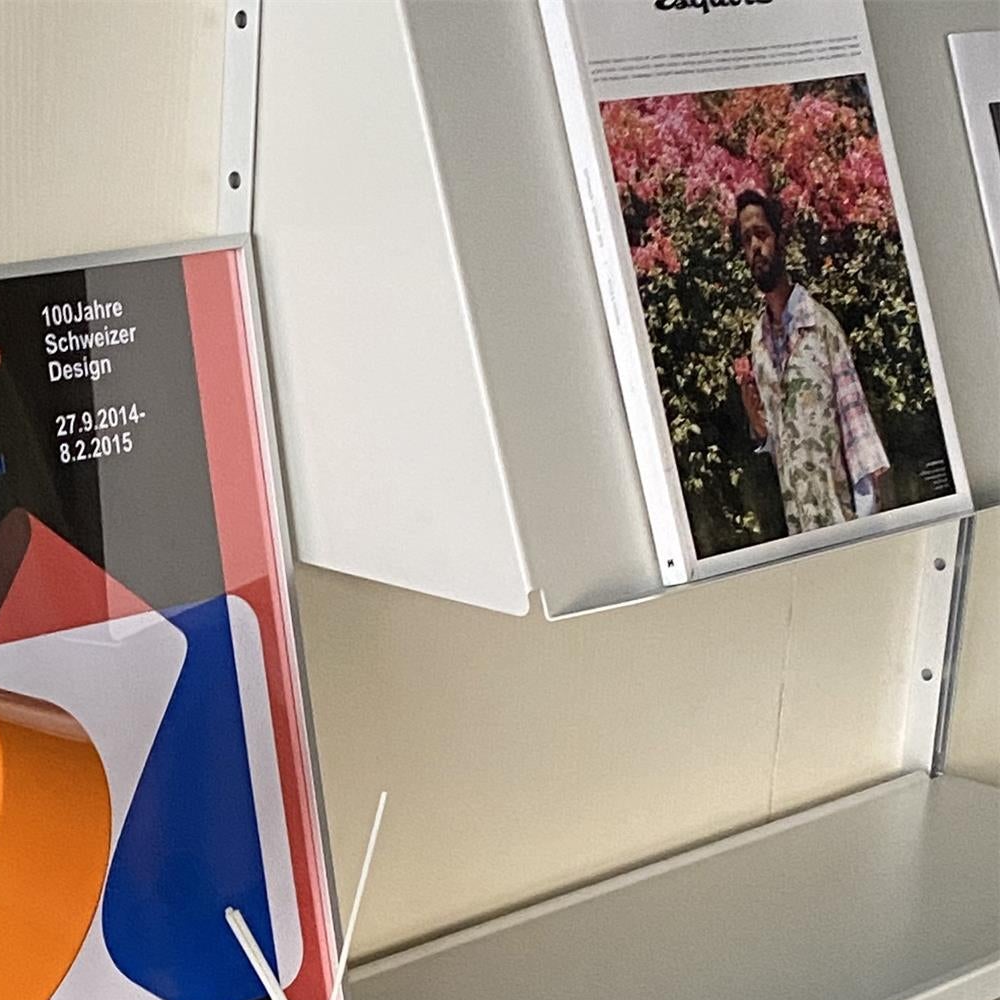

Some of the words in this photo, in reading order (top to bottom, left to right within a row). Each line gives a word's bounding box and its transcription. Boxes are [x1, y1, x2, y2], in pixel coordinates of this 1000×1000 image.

[42, 300, 123, 326] 100Jahre
[45, 325, 136, 354] Schweizer
[48, 356, 112, 382] Design
[56, 403, 146, 437] 27.9.2014-
[59, 432, 133, 463] 8.2.2015
